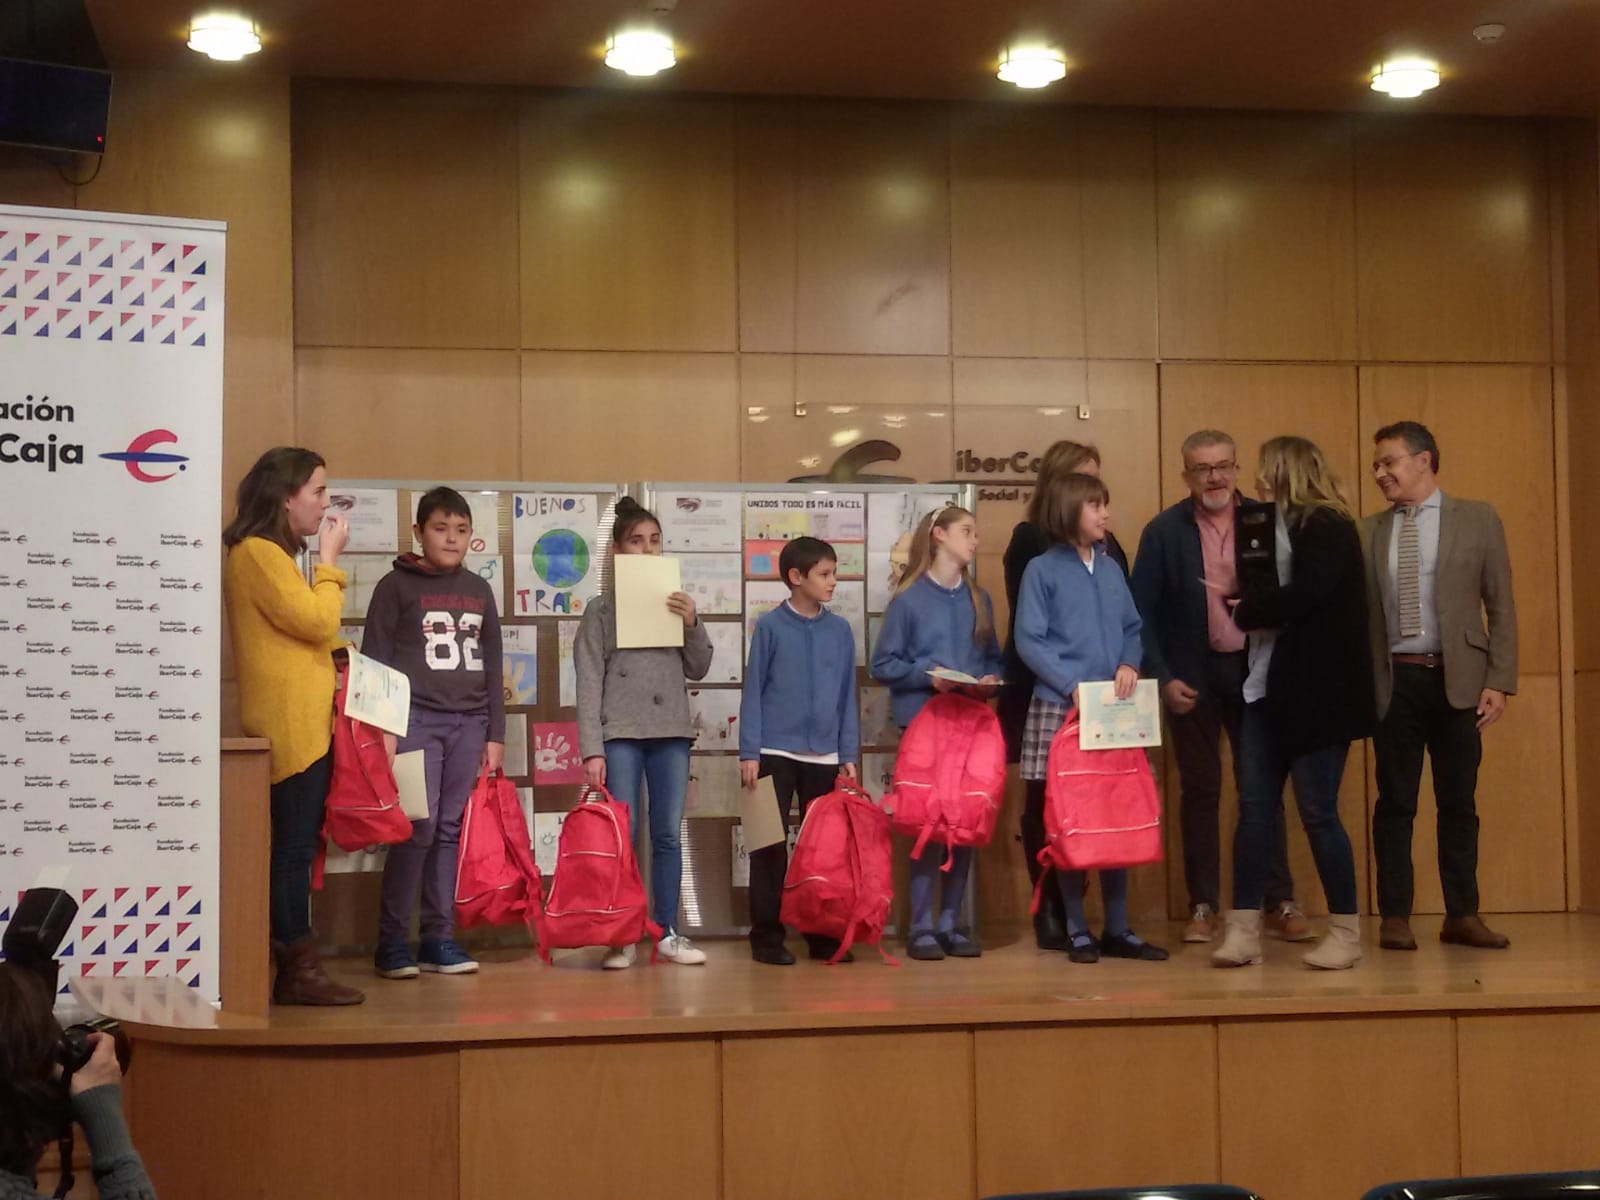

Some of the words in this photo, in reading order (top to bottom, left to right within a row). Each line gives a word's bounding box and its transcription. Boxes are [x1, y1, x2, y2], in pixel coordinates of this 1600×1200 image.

[515, 496, 586, 518] BUENOS
[747, 500, 779, 508] UNIDOS
[782, 500, 804, 508] TODO
[806, 500, 816, 508] ES
[422, 611, 484, 671] 82
